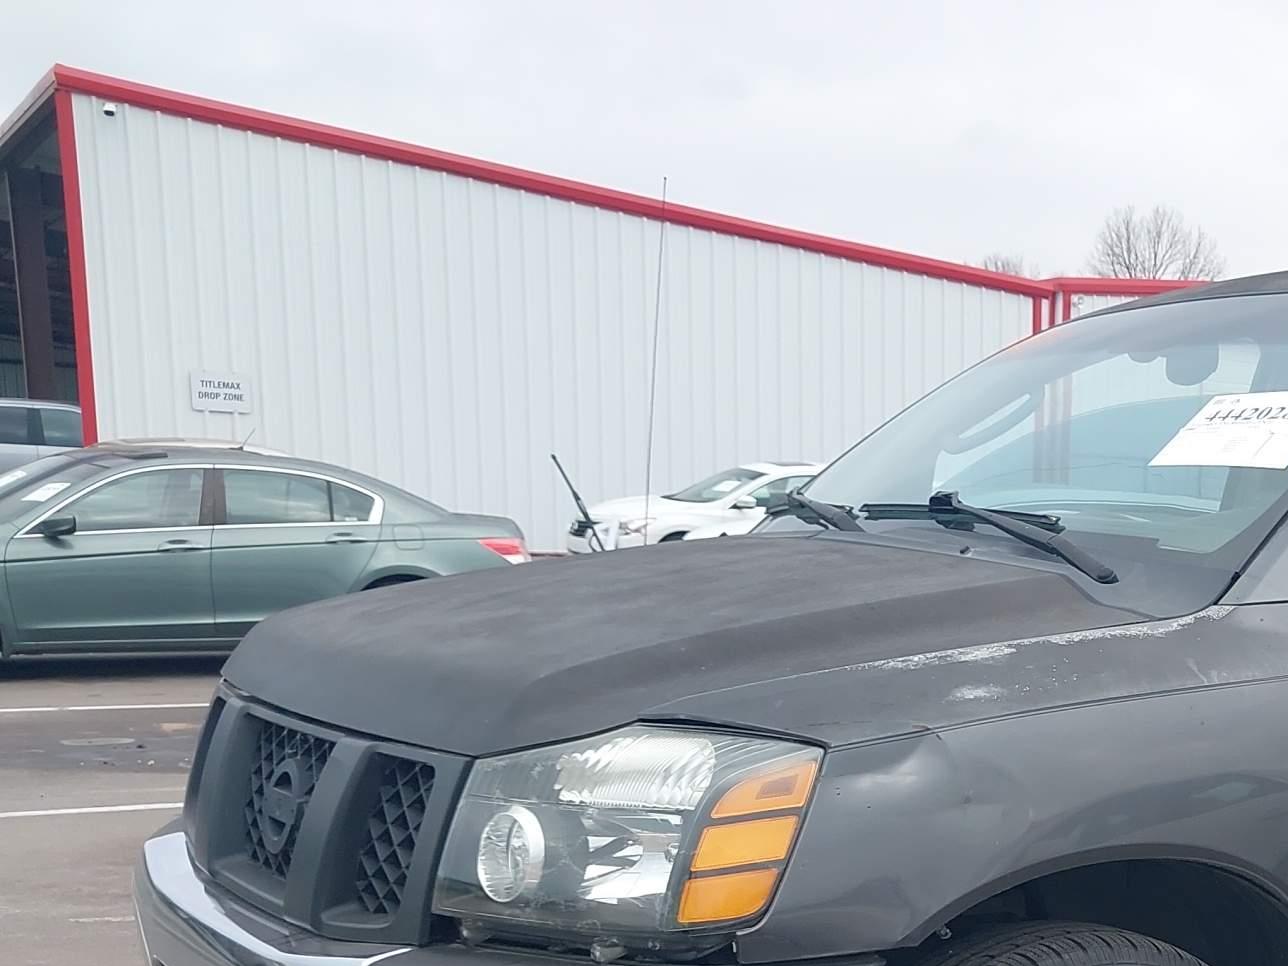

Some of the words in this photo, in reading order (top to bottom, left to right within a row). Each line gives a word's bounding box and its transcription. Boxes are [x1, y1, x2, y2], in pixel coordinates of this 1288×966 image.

[200, 379, 241, 390] TITLEMAX
[198, 391, 220, 400] DROP
[224, 392, 245, 402] ZONE
